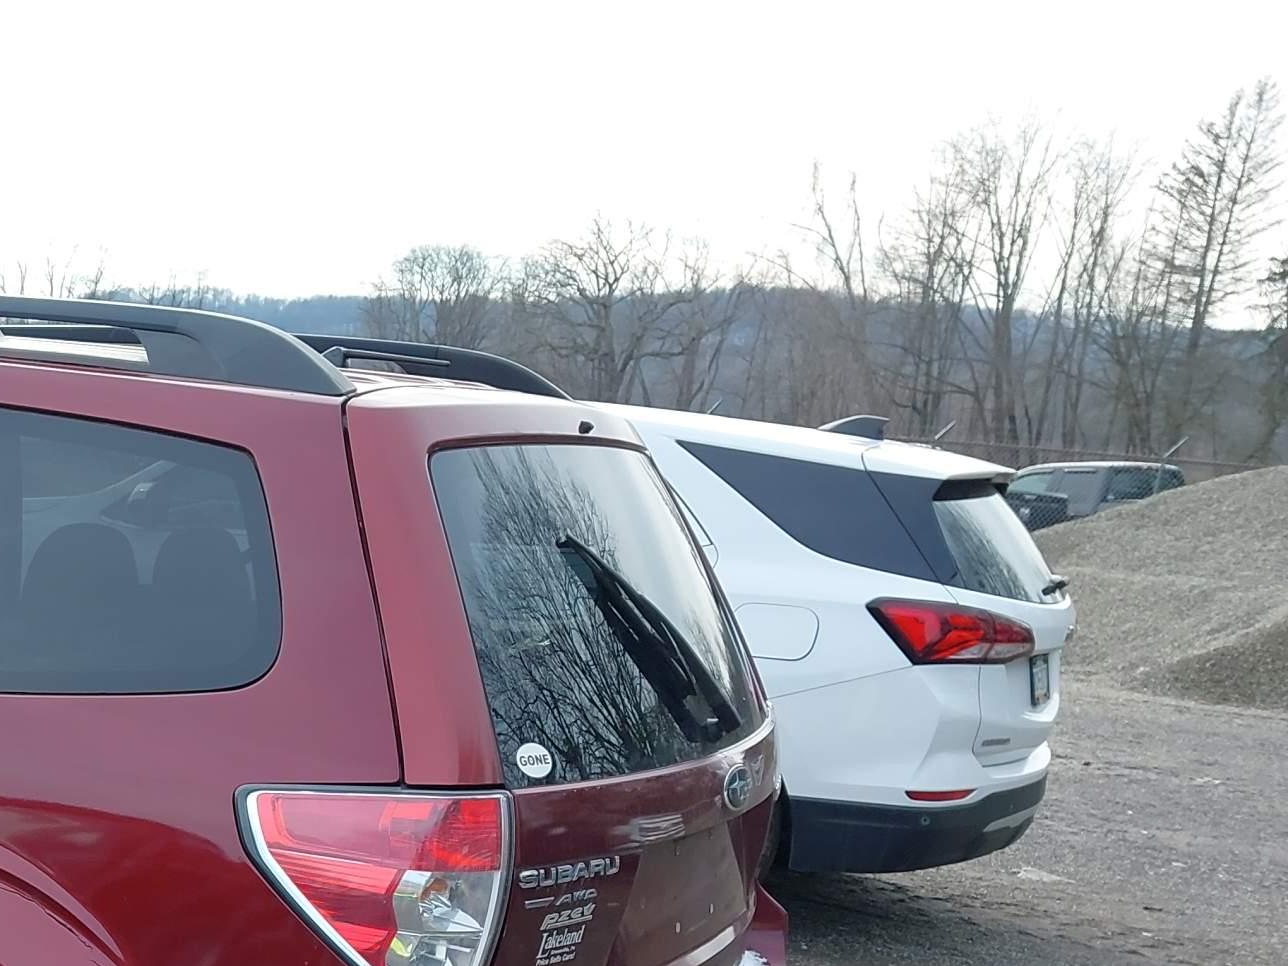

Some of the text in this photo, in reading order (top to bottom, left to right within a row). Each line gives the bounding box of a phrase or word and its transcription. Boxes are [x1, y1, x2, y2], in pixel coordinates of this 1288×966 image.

[519, 753, 551, 768] GONE
[518, 856, 620, 889] SUBARU
[536, 924, 586, 958] Lakeland
